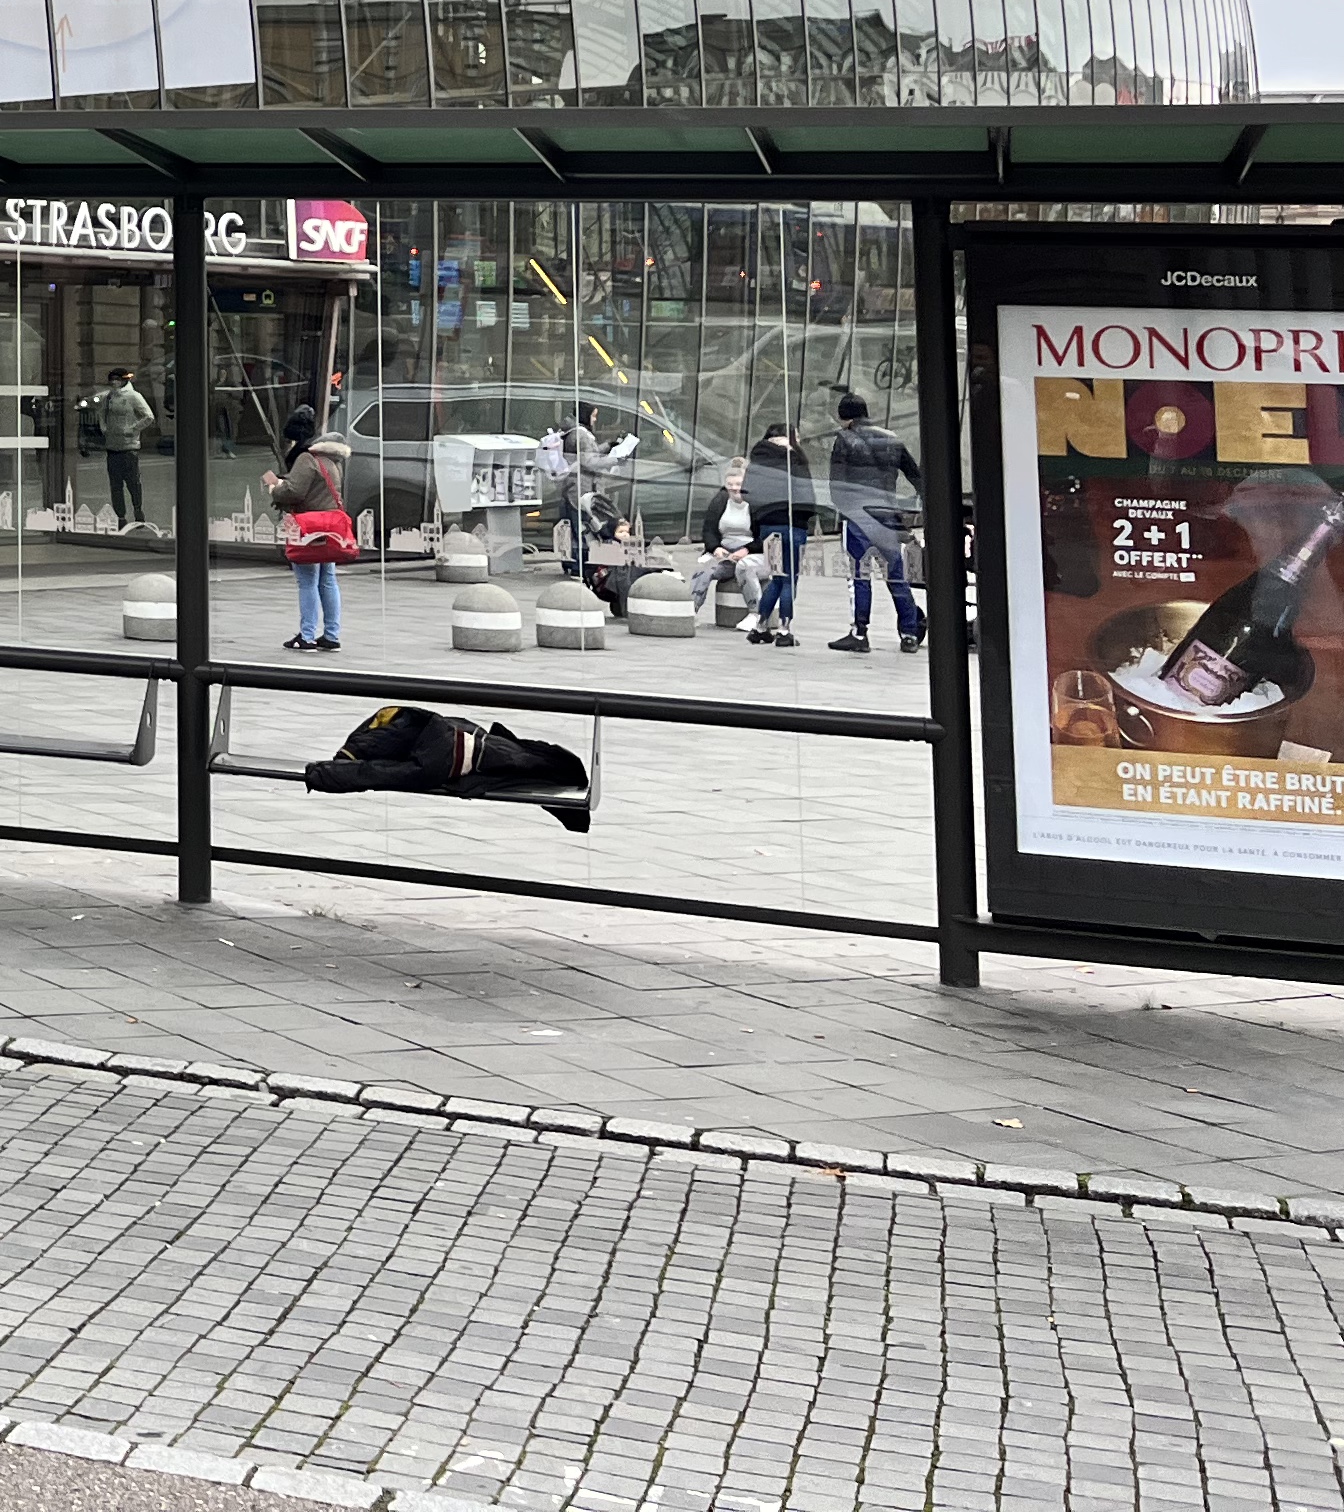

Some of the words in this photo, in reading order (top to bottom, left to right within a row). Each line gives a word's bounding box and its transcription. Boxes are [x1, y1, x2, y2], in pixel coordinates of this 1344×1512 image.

[3, 198, 248, 256] STRASBORG
[298, 217, 369, 254] SNCF
[1160, 270, 1258, 288] JCDecaux
[1031, 323, 1344, 374] MONOPRI
[1114, 498, 1187, 511] CHAMPAGNE
[1128, 509, 1174, 520] DEVAUX
[1112, 518, 1134, 547] 2
[1143, 525, 1166, 546] +
[1175, 521, 1191, 550] 1
[1116, 761, 1152, 781] ON
[1157, 764, 1216, 786] PEUT
[1221, 764, 1280, 790] ÊTRE
[1284, 772, 1344, 794] BRUT
[1122, 783, 1153, 802] EN
[1158, 782, 1232, 808] ÉTANT
[1236, 790, 1343, 816] RAFFINÉ.
